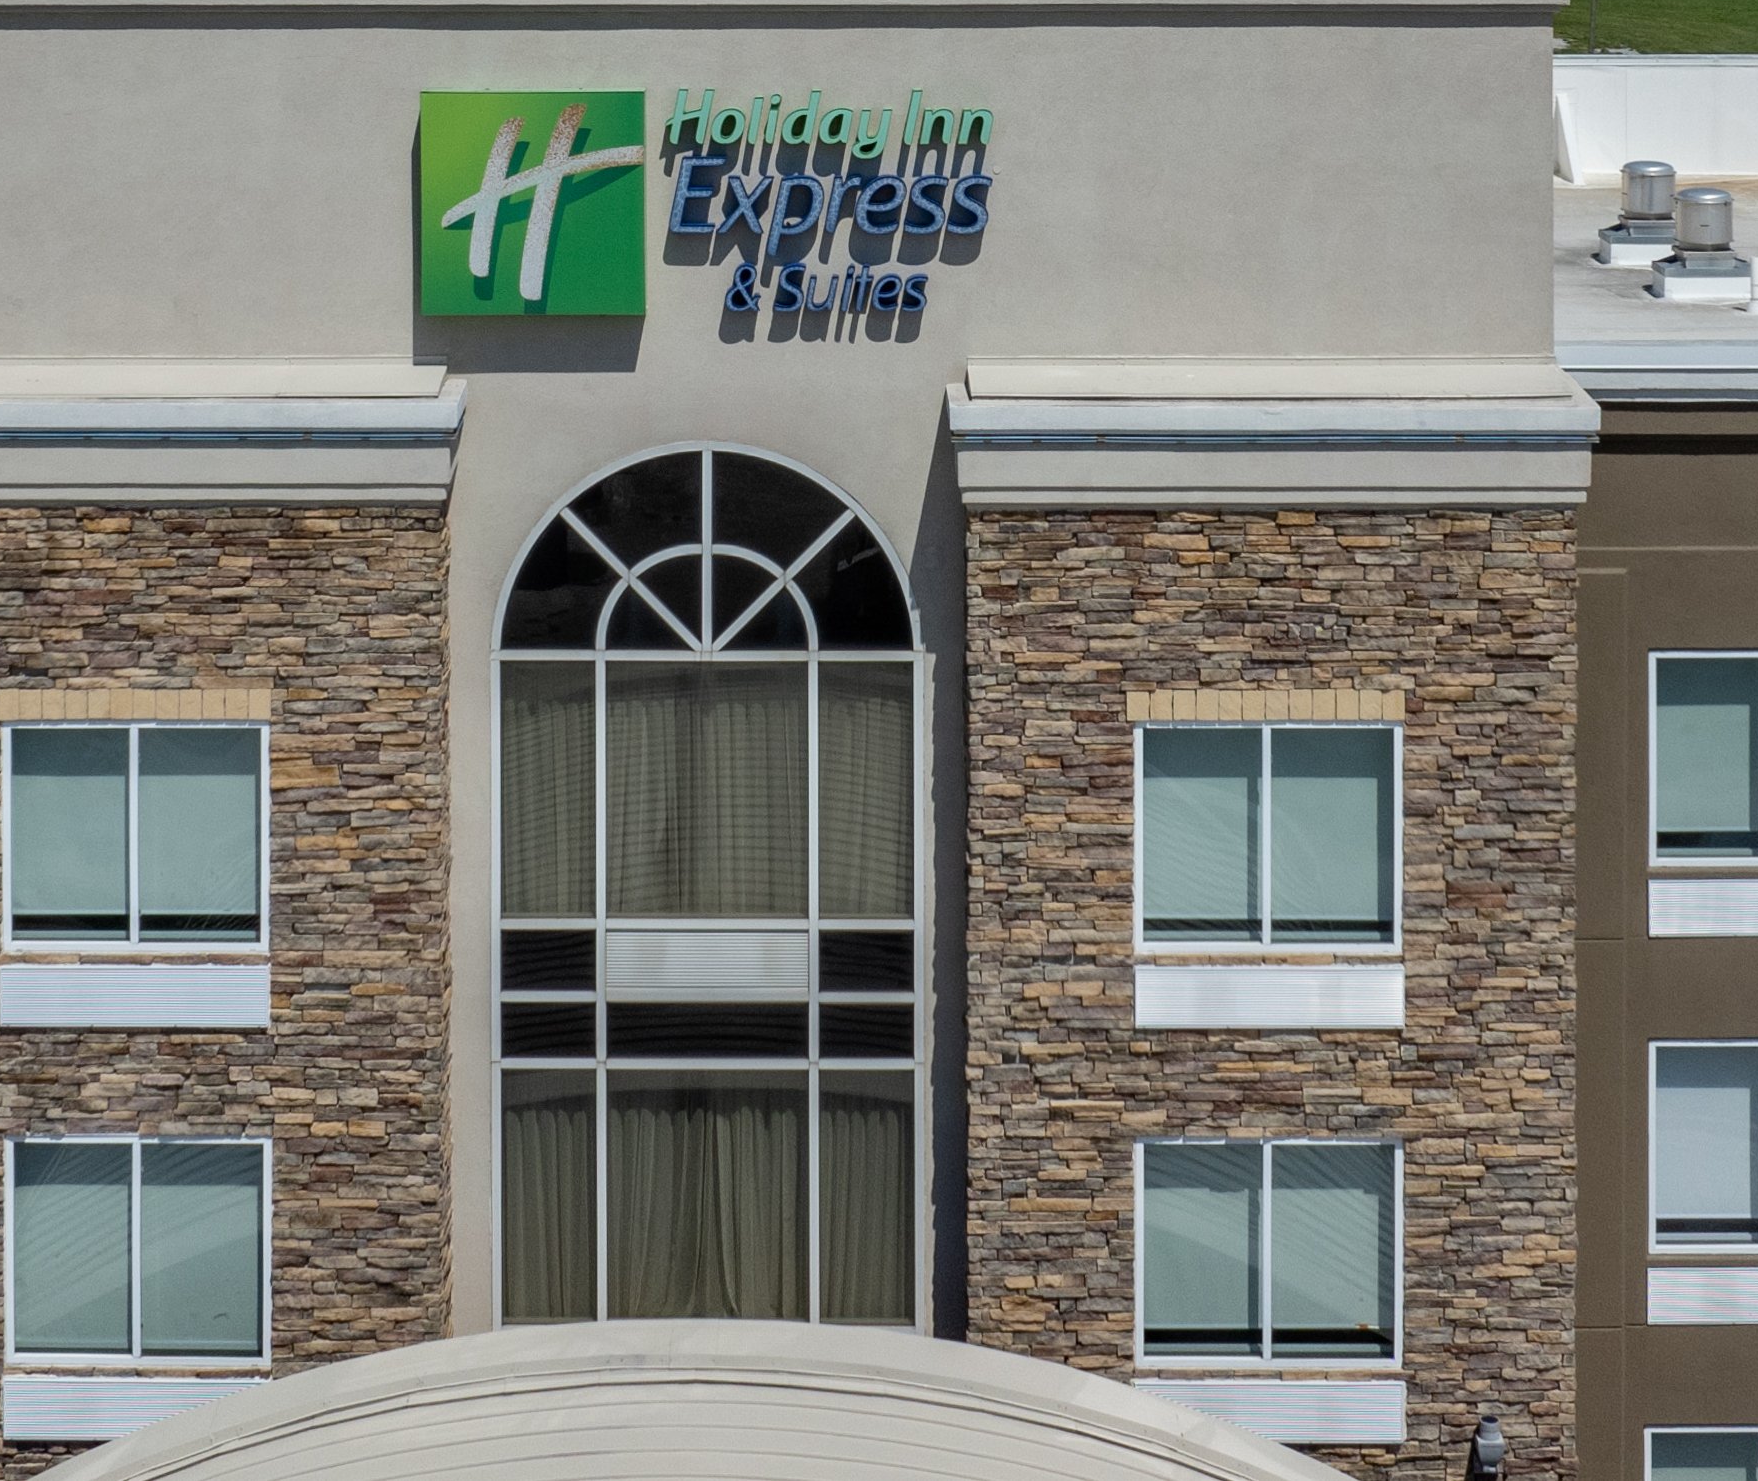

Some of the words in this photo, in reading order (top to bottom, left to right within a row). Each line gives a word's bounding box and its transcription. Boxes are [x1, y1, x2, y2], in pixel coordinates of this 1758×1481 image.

[666, 89, 892, 159] Holiday
[903, 89, 994, 145] Inn
[669, 156, 992, 255] Express
[725, 262, 761, 311] &
[773, 262, 928, 311] Suites
